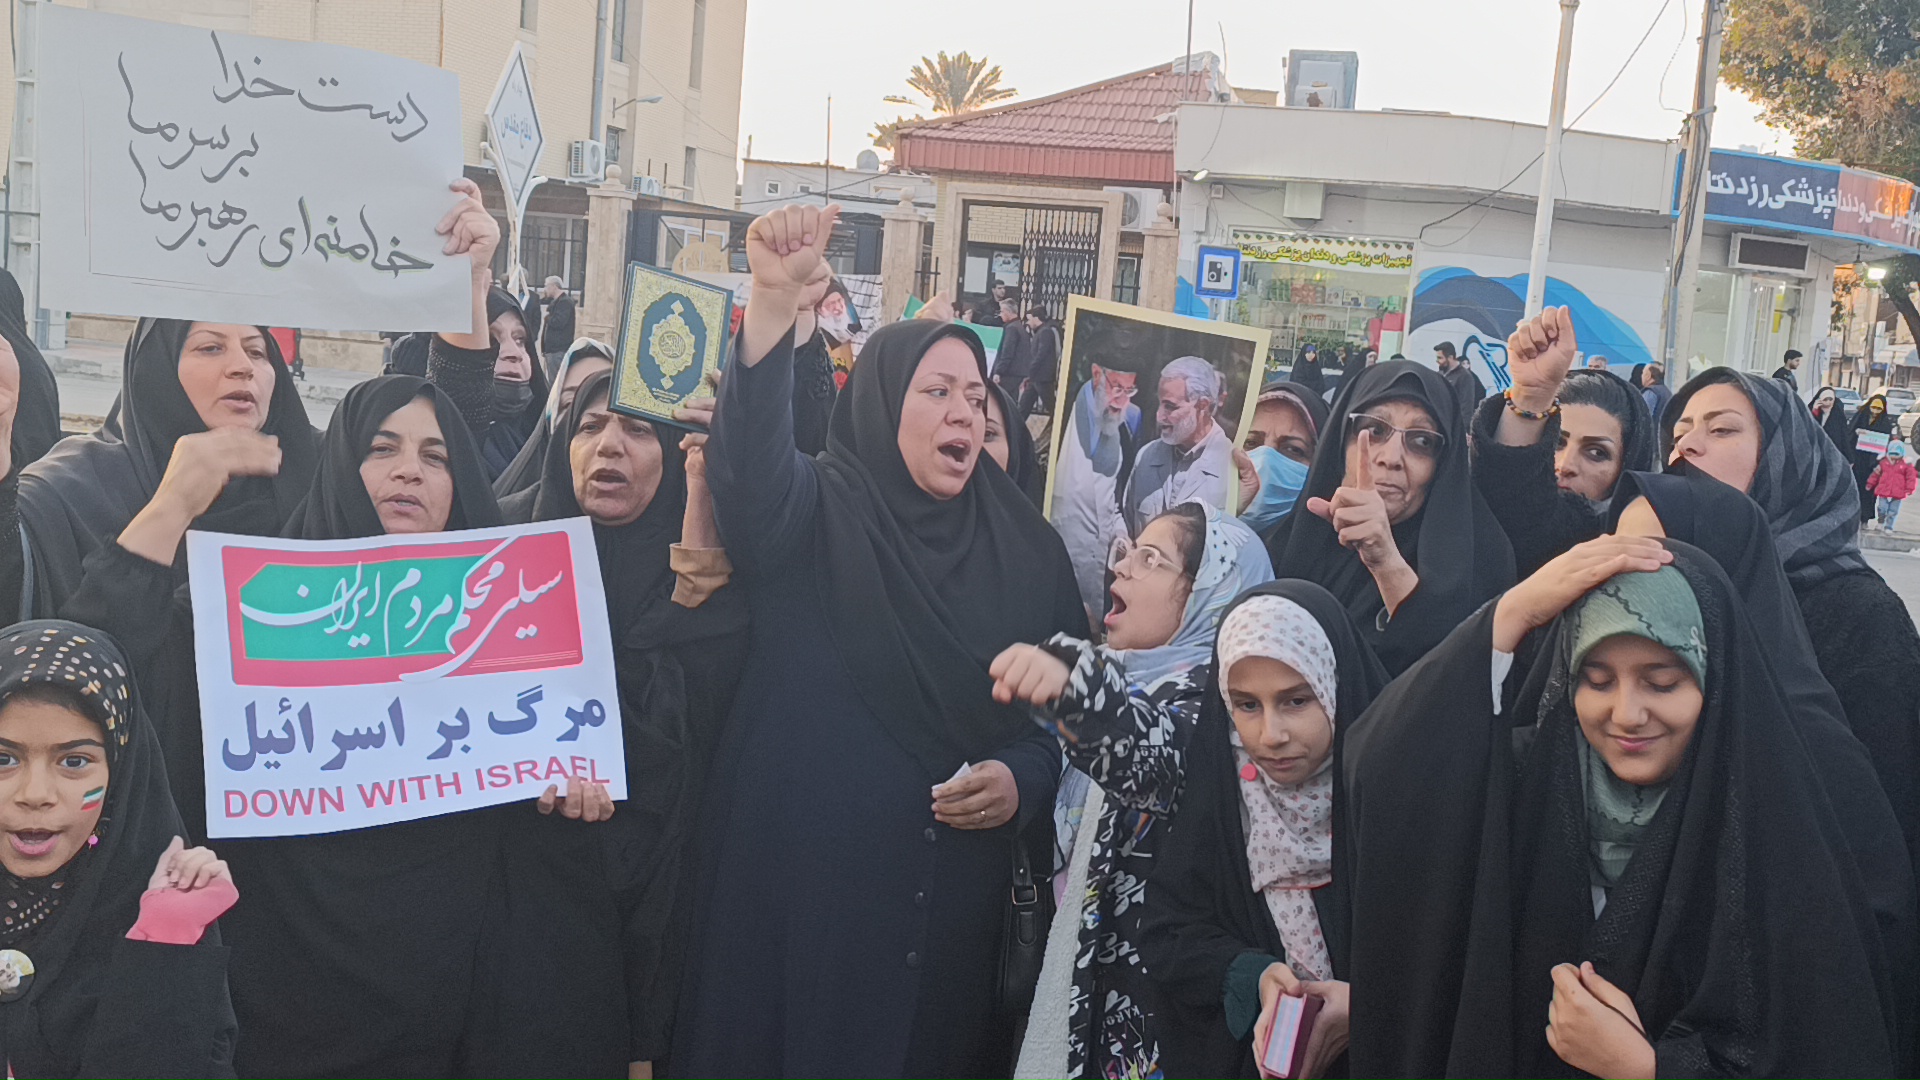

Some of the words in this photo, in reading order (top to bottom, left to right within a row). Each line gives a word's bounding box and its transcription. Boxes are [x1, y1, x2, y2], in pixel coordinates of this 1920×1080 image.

[117, 51, 180, 142] ما
[210, 30, 295, 104] خدا
[297, 77, 429, 142] دست
[157, 124, 230, 170] سر
[201, 131, 260, 183] بر
[129, 140, 181, 222] ما
[1705, 171, 1749, 196] دنتا
[155, 200, 260, 267] رهبر
[1337, 250, 1372, 267] پزشکی
[1371, 252, 1413, 269] تجهیزات
[239, 560, 382, 648] ایران
[384, 567, 453, 657] مردم
[399, 568, 563, 683] سیلی
[445, 535, 520, 655] محکم
[222, 695, 406, 771] اسرائیل
[427, 706, 472, 760] بر
[487, 684, 607, 742] مرگ
[223, 785, 346, 819] DOWN
[356, 771, 464, 810] WITH
[475, 755, 611, 792] ISRAEL
